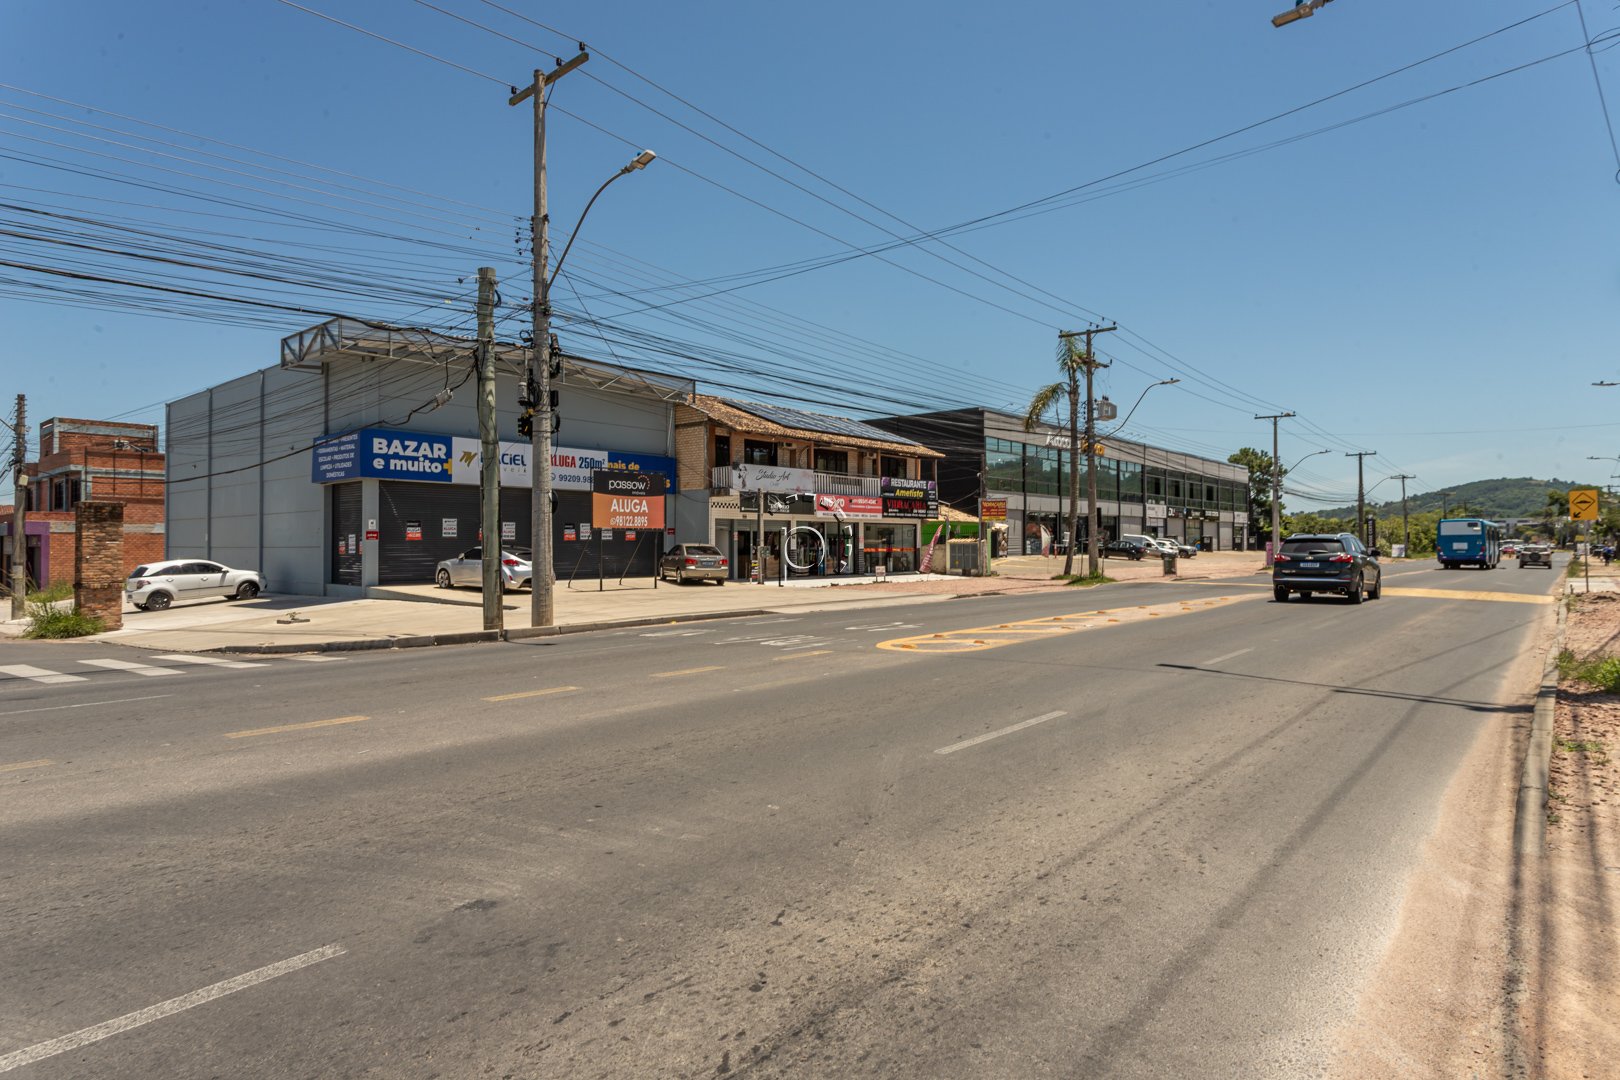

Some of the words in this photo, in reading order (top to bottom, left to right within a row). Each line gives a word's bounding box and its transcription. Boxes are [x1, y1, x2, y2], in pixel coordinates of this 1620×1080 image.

[372, 437, 446, 458] BAZAR
[372, 458, 384, 469] e
[628, 461, 640, 470] de
[608, 480, 646, 490] passow
[890, 478, 926, 489] RESTAURANTE
[895, 489, 924, 498] Ametista
[610, 498, 648, 513] ALUGA
